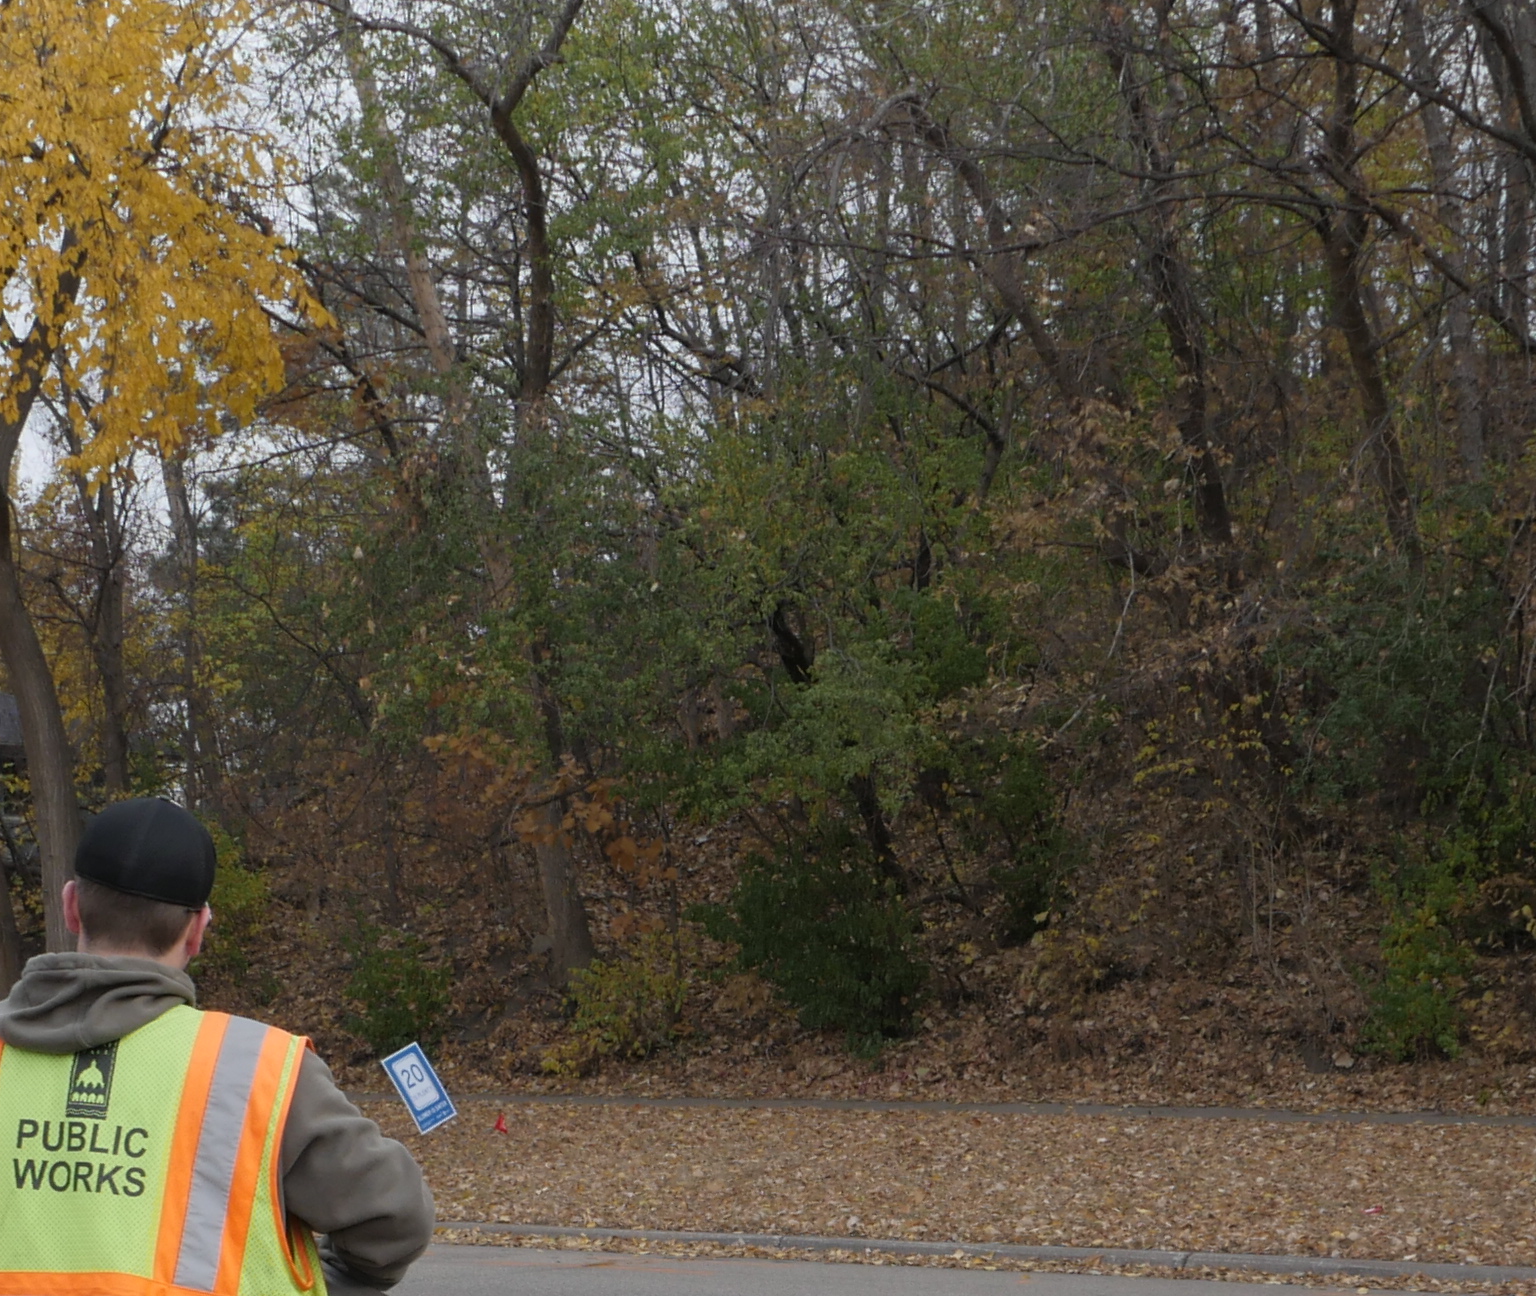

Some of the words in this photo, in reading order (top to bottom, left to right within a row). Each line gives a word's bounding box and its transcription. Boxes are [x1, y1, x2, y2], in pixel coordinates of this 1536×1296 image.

[401, 1063, 424, 1089] 20
[16, 1119, 149, 1159] PUBLIC
[13, 1158, 146, 1197] WORKS
